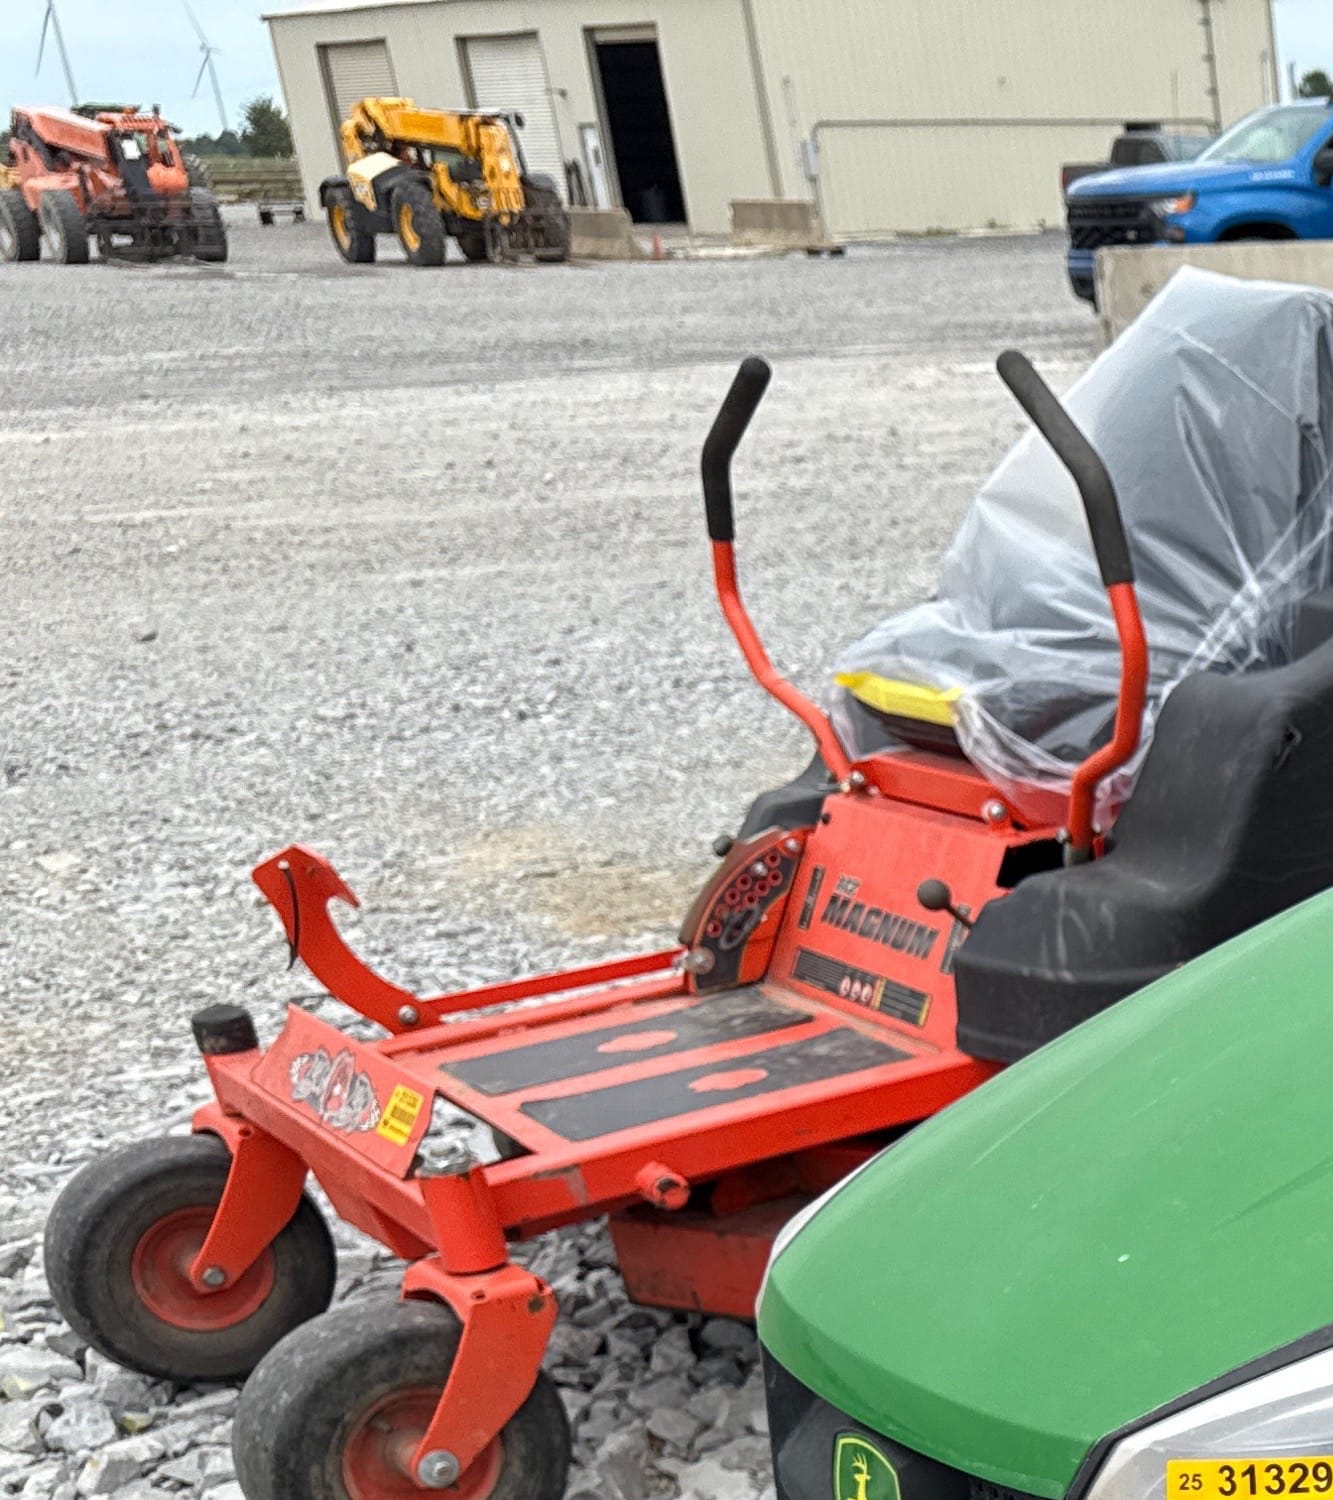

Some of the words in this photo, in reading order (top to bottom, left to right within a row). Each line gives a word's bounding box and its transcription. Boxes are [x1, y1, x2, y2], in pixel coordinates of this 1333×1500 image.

[821, 892, 939, 961] MAGNUM
[1178, 1473, 1203, 1491] 25
[1217, 1461, 1333, 1497] 31329
